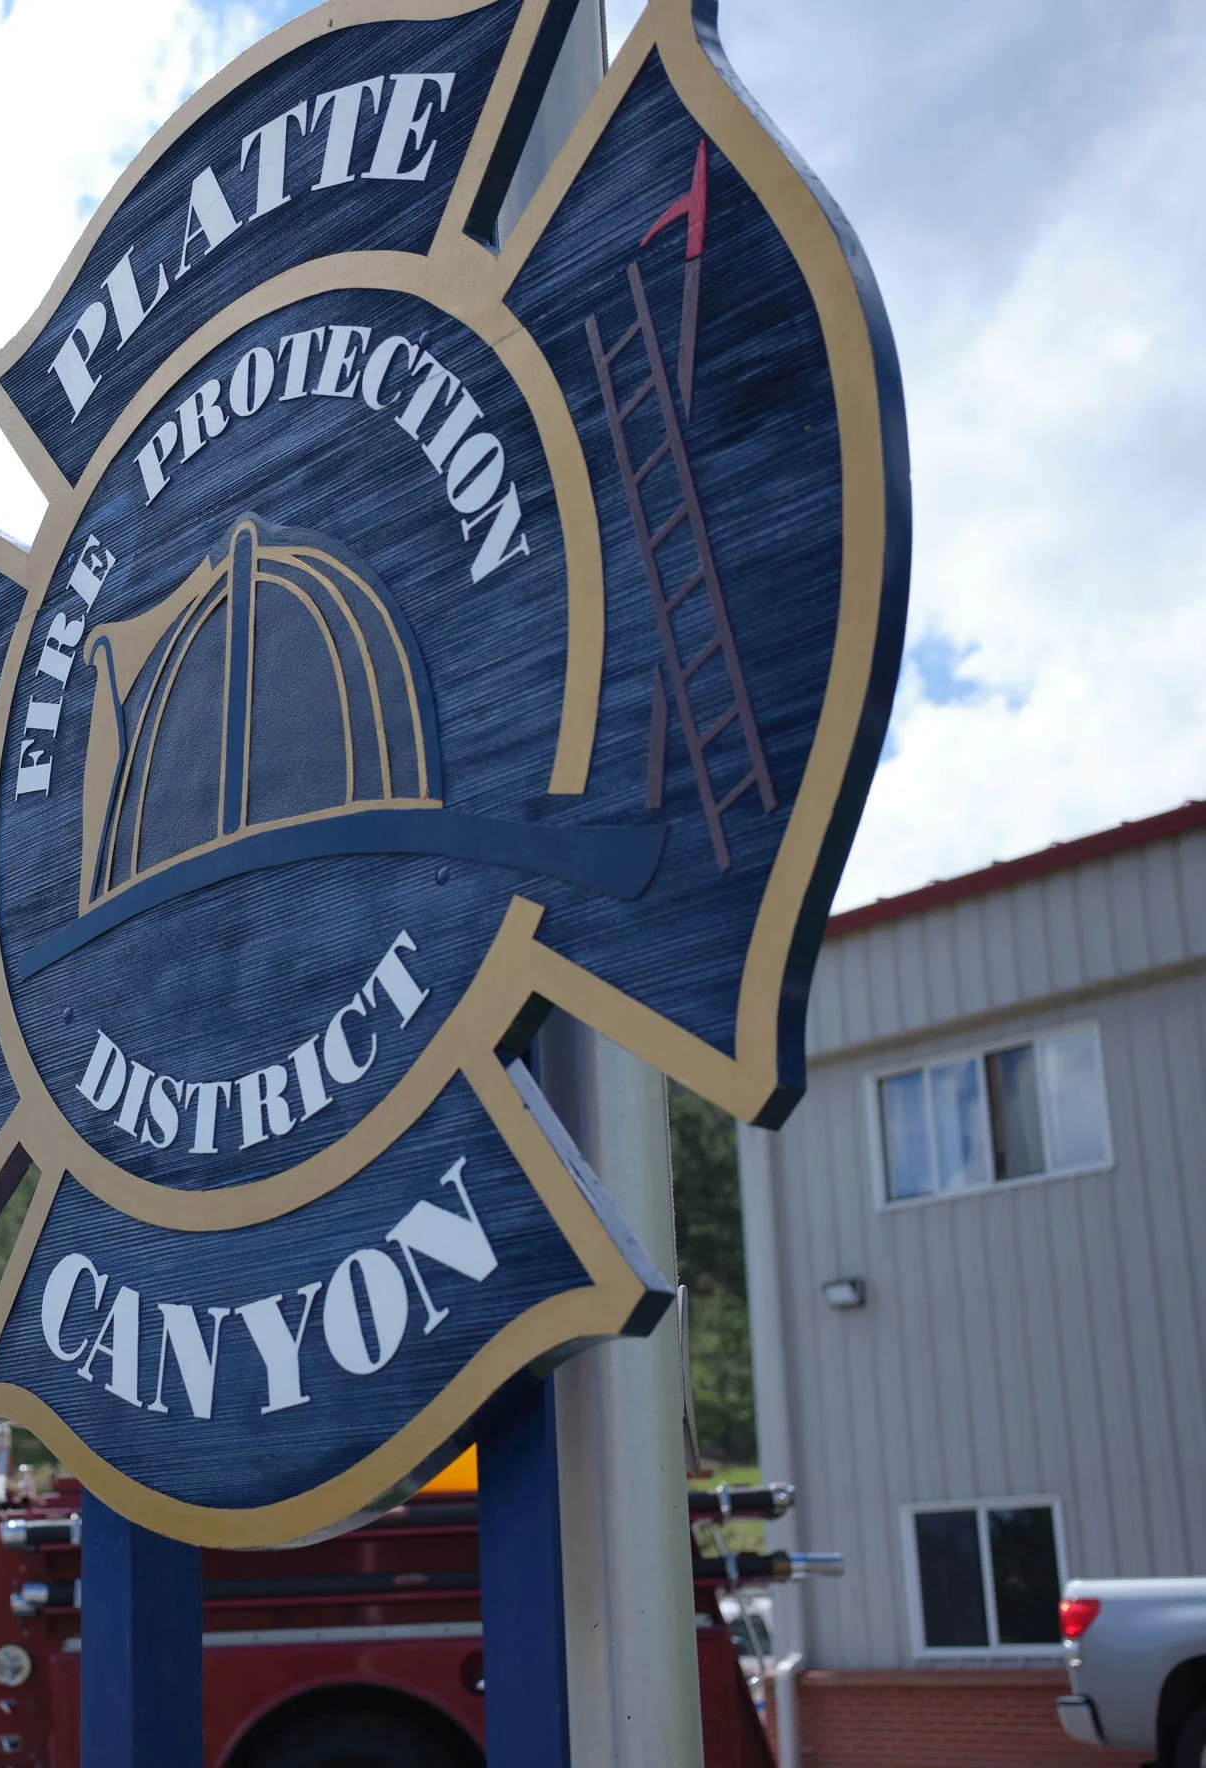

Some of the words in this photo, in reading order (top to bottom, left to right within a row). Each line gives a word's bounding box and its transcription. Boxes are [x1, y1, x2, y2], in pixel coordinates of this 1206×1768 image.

[47, 72, 456, 424] PLATTE
[15, 534, 116, 801] FIRE
[133, 324, 530, 584] PROTECTION
[75, 930, 430, 1154] DISTRICT
[41, 1156, 499, 1419] CANYON
